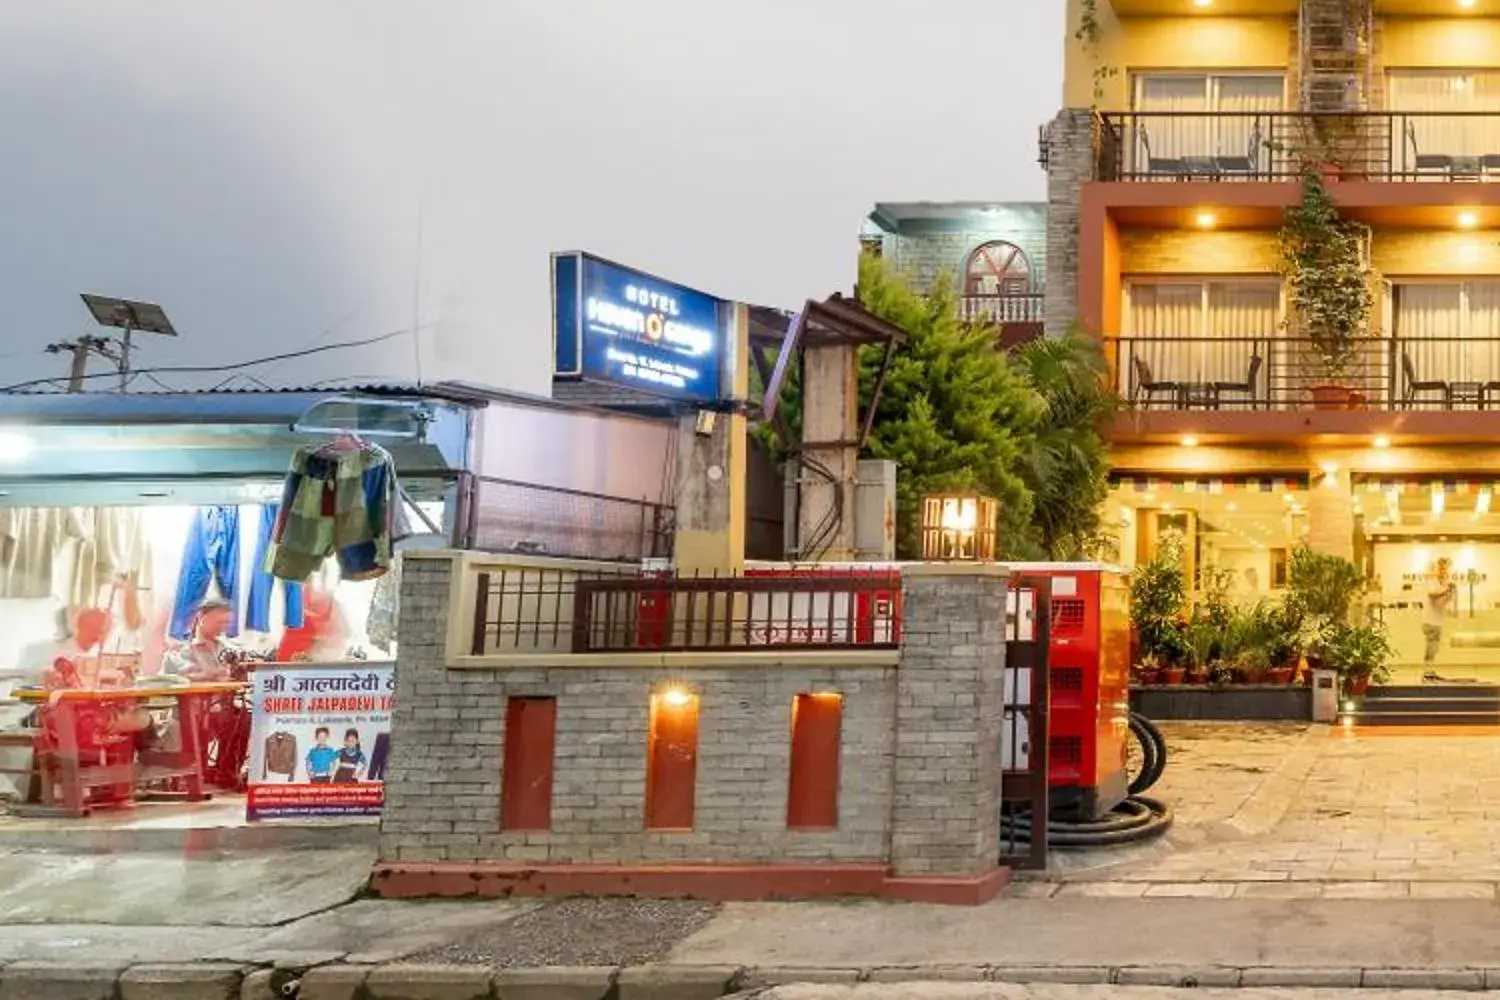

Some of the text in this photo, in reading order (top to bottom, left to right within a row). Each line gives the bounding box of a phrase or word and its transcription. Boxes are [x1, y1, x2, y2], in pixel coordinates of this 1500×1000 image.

[263, 674, 286, 692] श्री
[263, 696, 302, 713] SHREE
[307, 695, 375, 712] JALPADEVI
